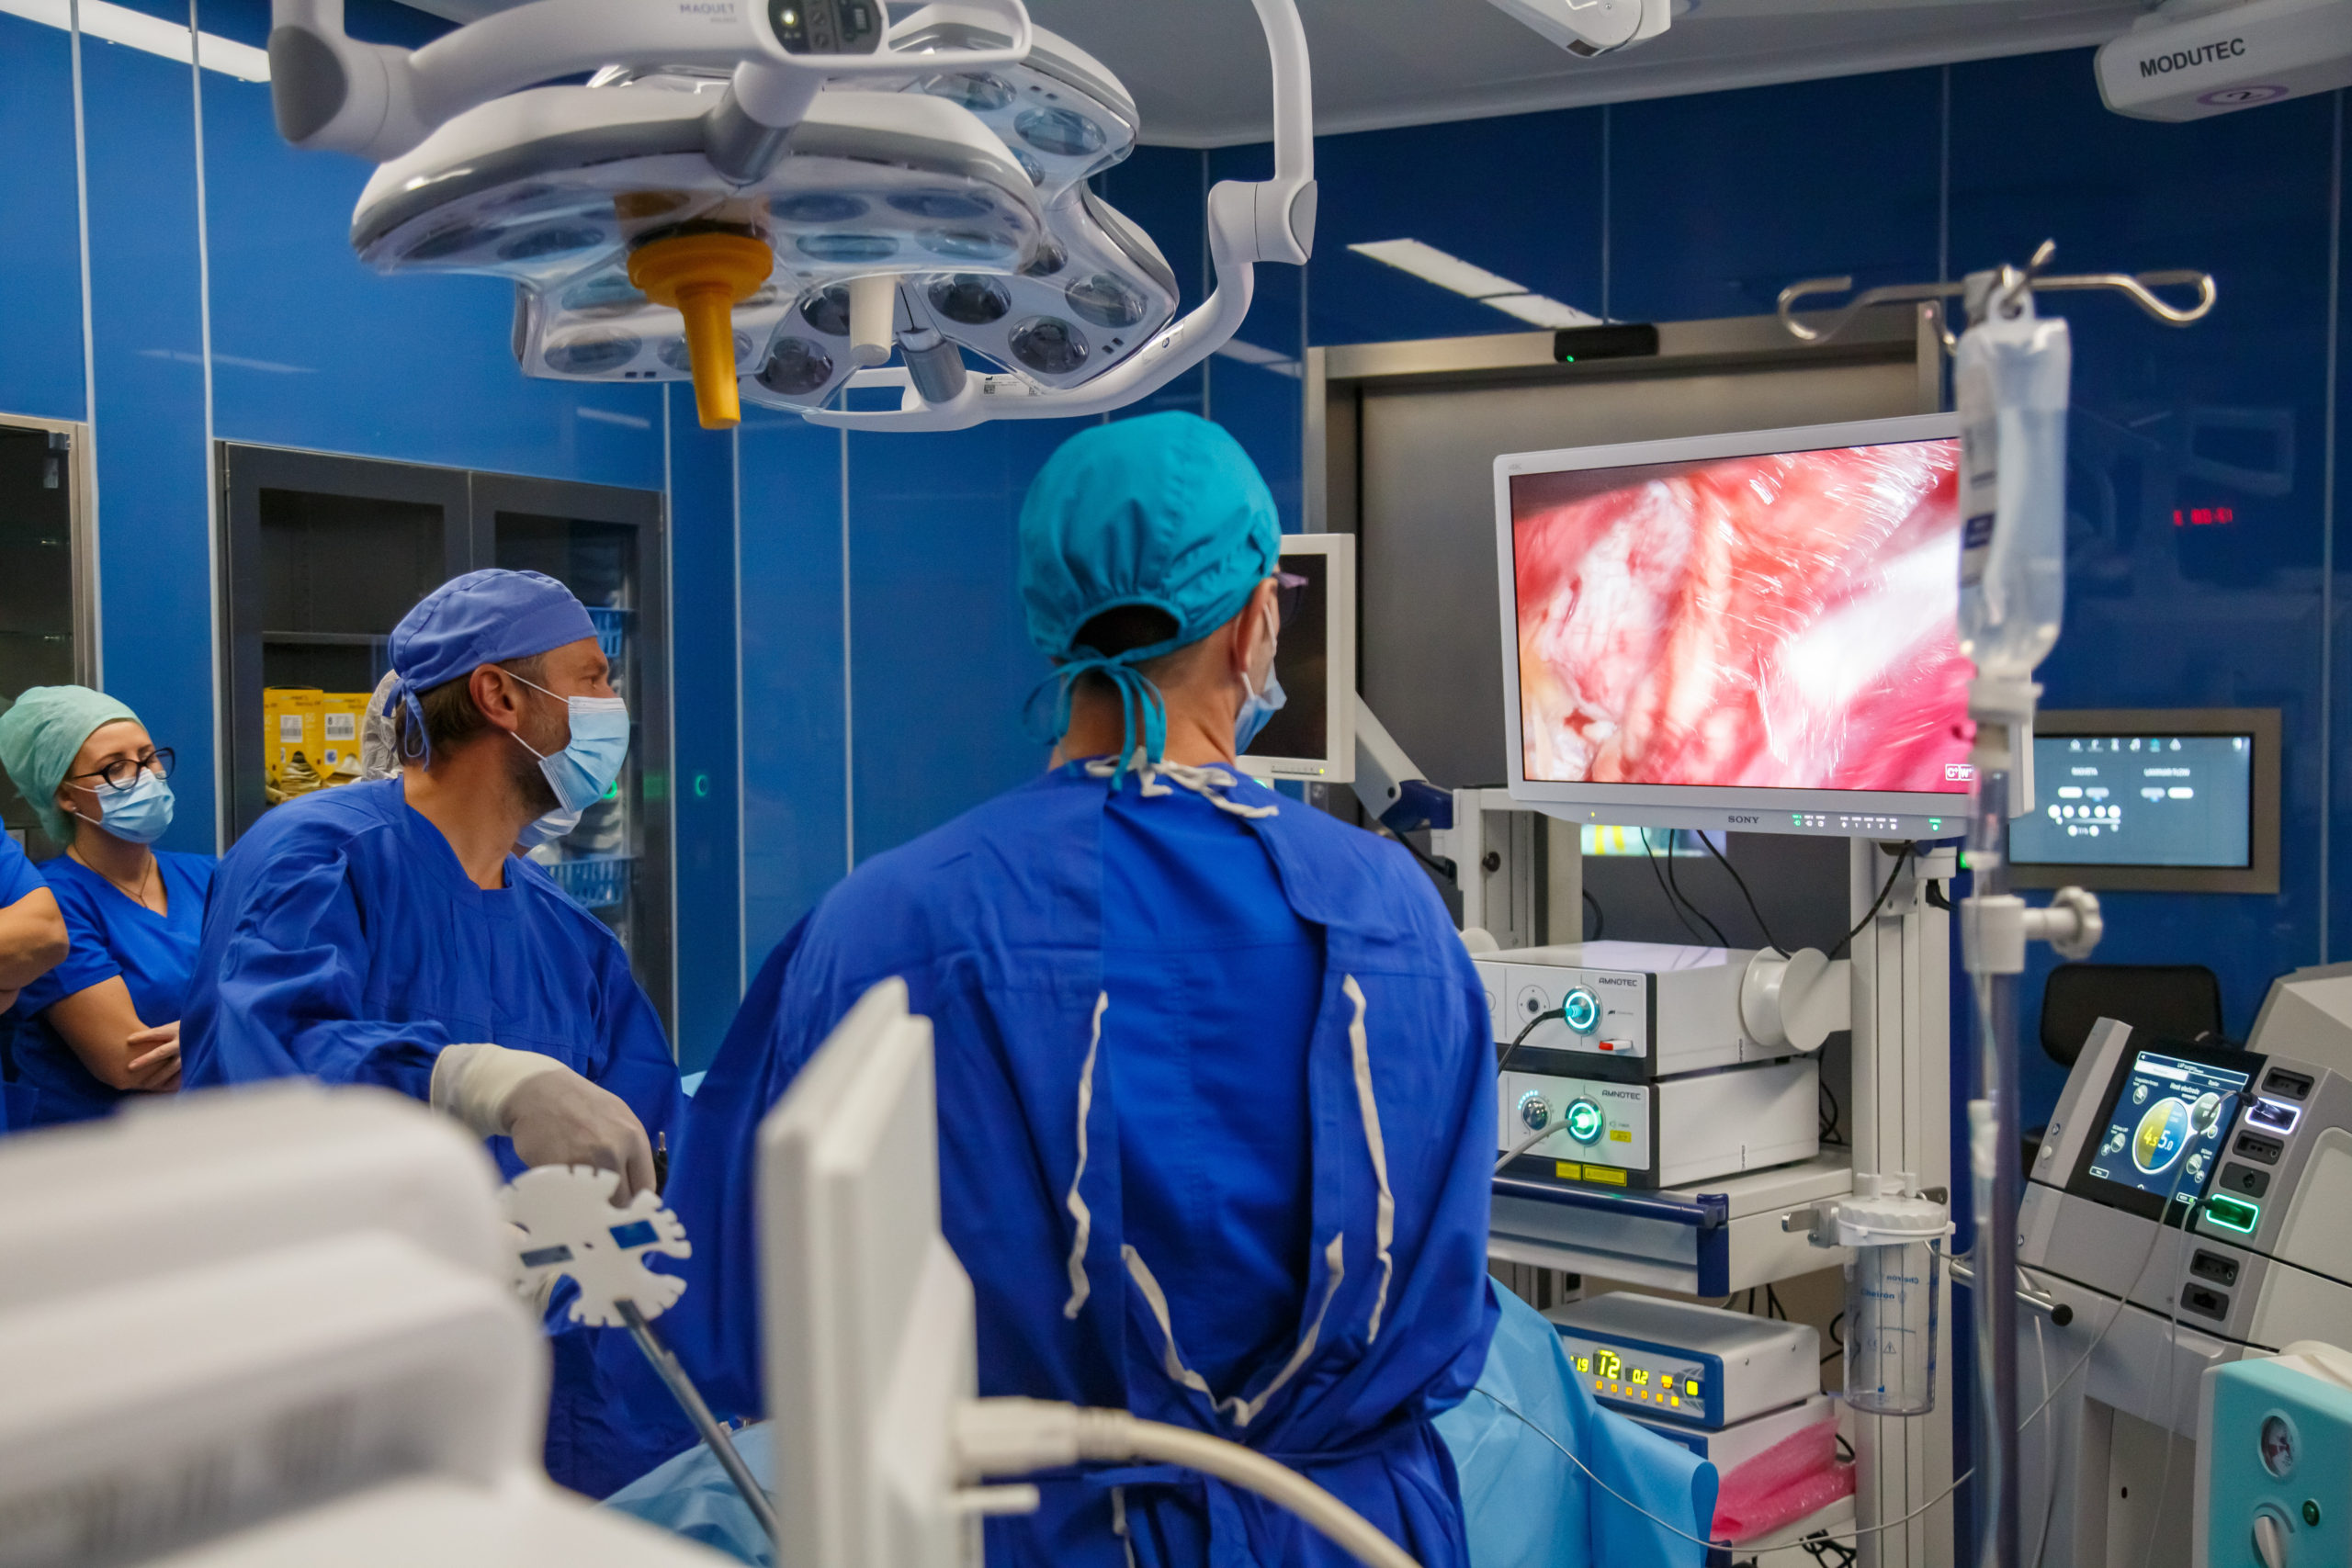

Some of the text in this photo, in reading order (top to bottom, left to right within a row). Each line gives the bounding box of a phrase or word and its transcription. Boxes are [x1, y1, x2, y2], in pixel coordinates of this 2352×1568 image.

[2140, 38, 2246, 78] MODUTEC
[1727, 815, 1760, 824] SONY
[1599, 977, 1637, 987] AMNOTEC
[1602, 1089, 1641, 1100] AMNOTEC
[1600, 1356, 1621, 1380] 12
